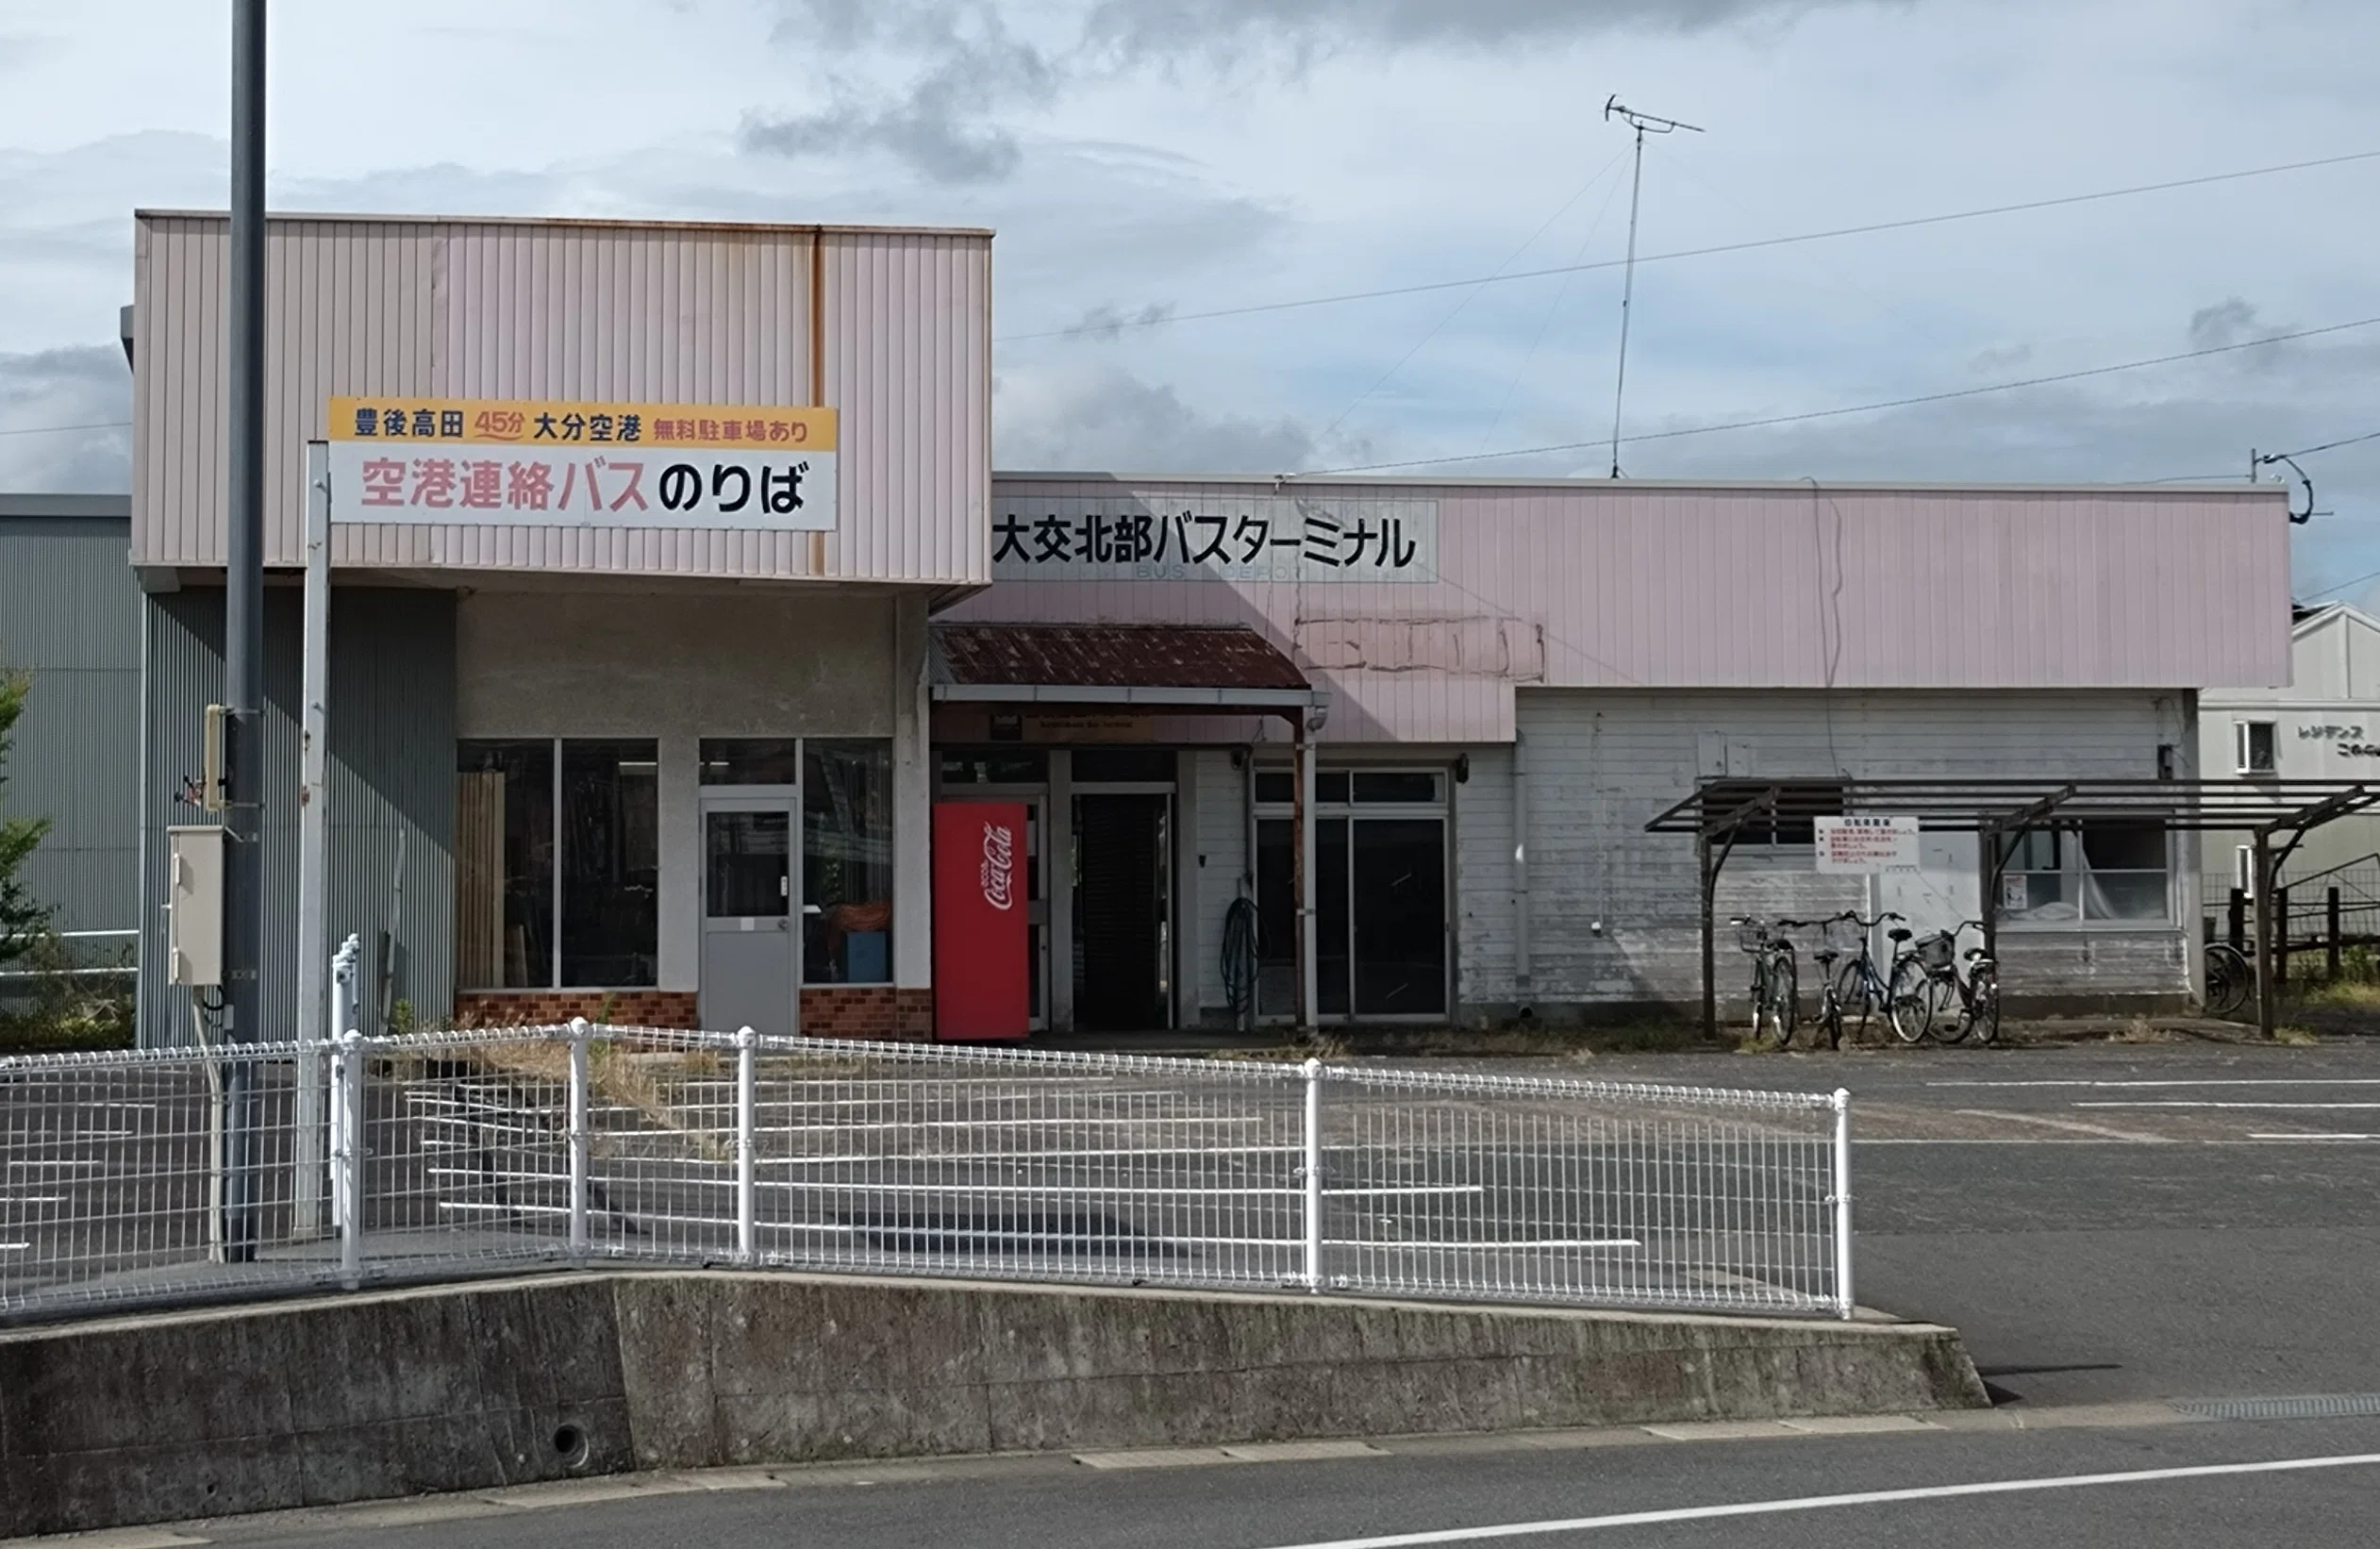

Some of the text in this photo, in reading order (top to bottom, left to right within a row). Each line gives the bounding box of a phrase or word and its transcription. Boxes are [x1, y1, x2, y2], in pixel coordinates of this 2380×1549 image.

[355, 408, 808, 443] 豊後高田 45分 大分空港 無料駐車場あり
[992, 509, 1416, 568] 大交北部バスターミナル
[1137, 564, 1185, 578] BUS
[2298, 725, 2365, 740] レジデンス
[983, 821, 1012, 910] Coca-Cola
